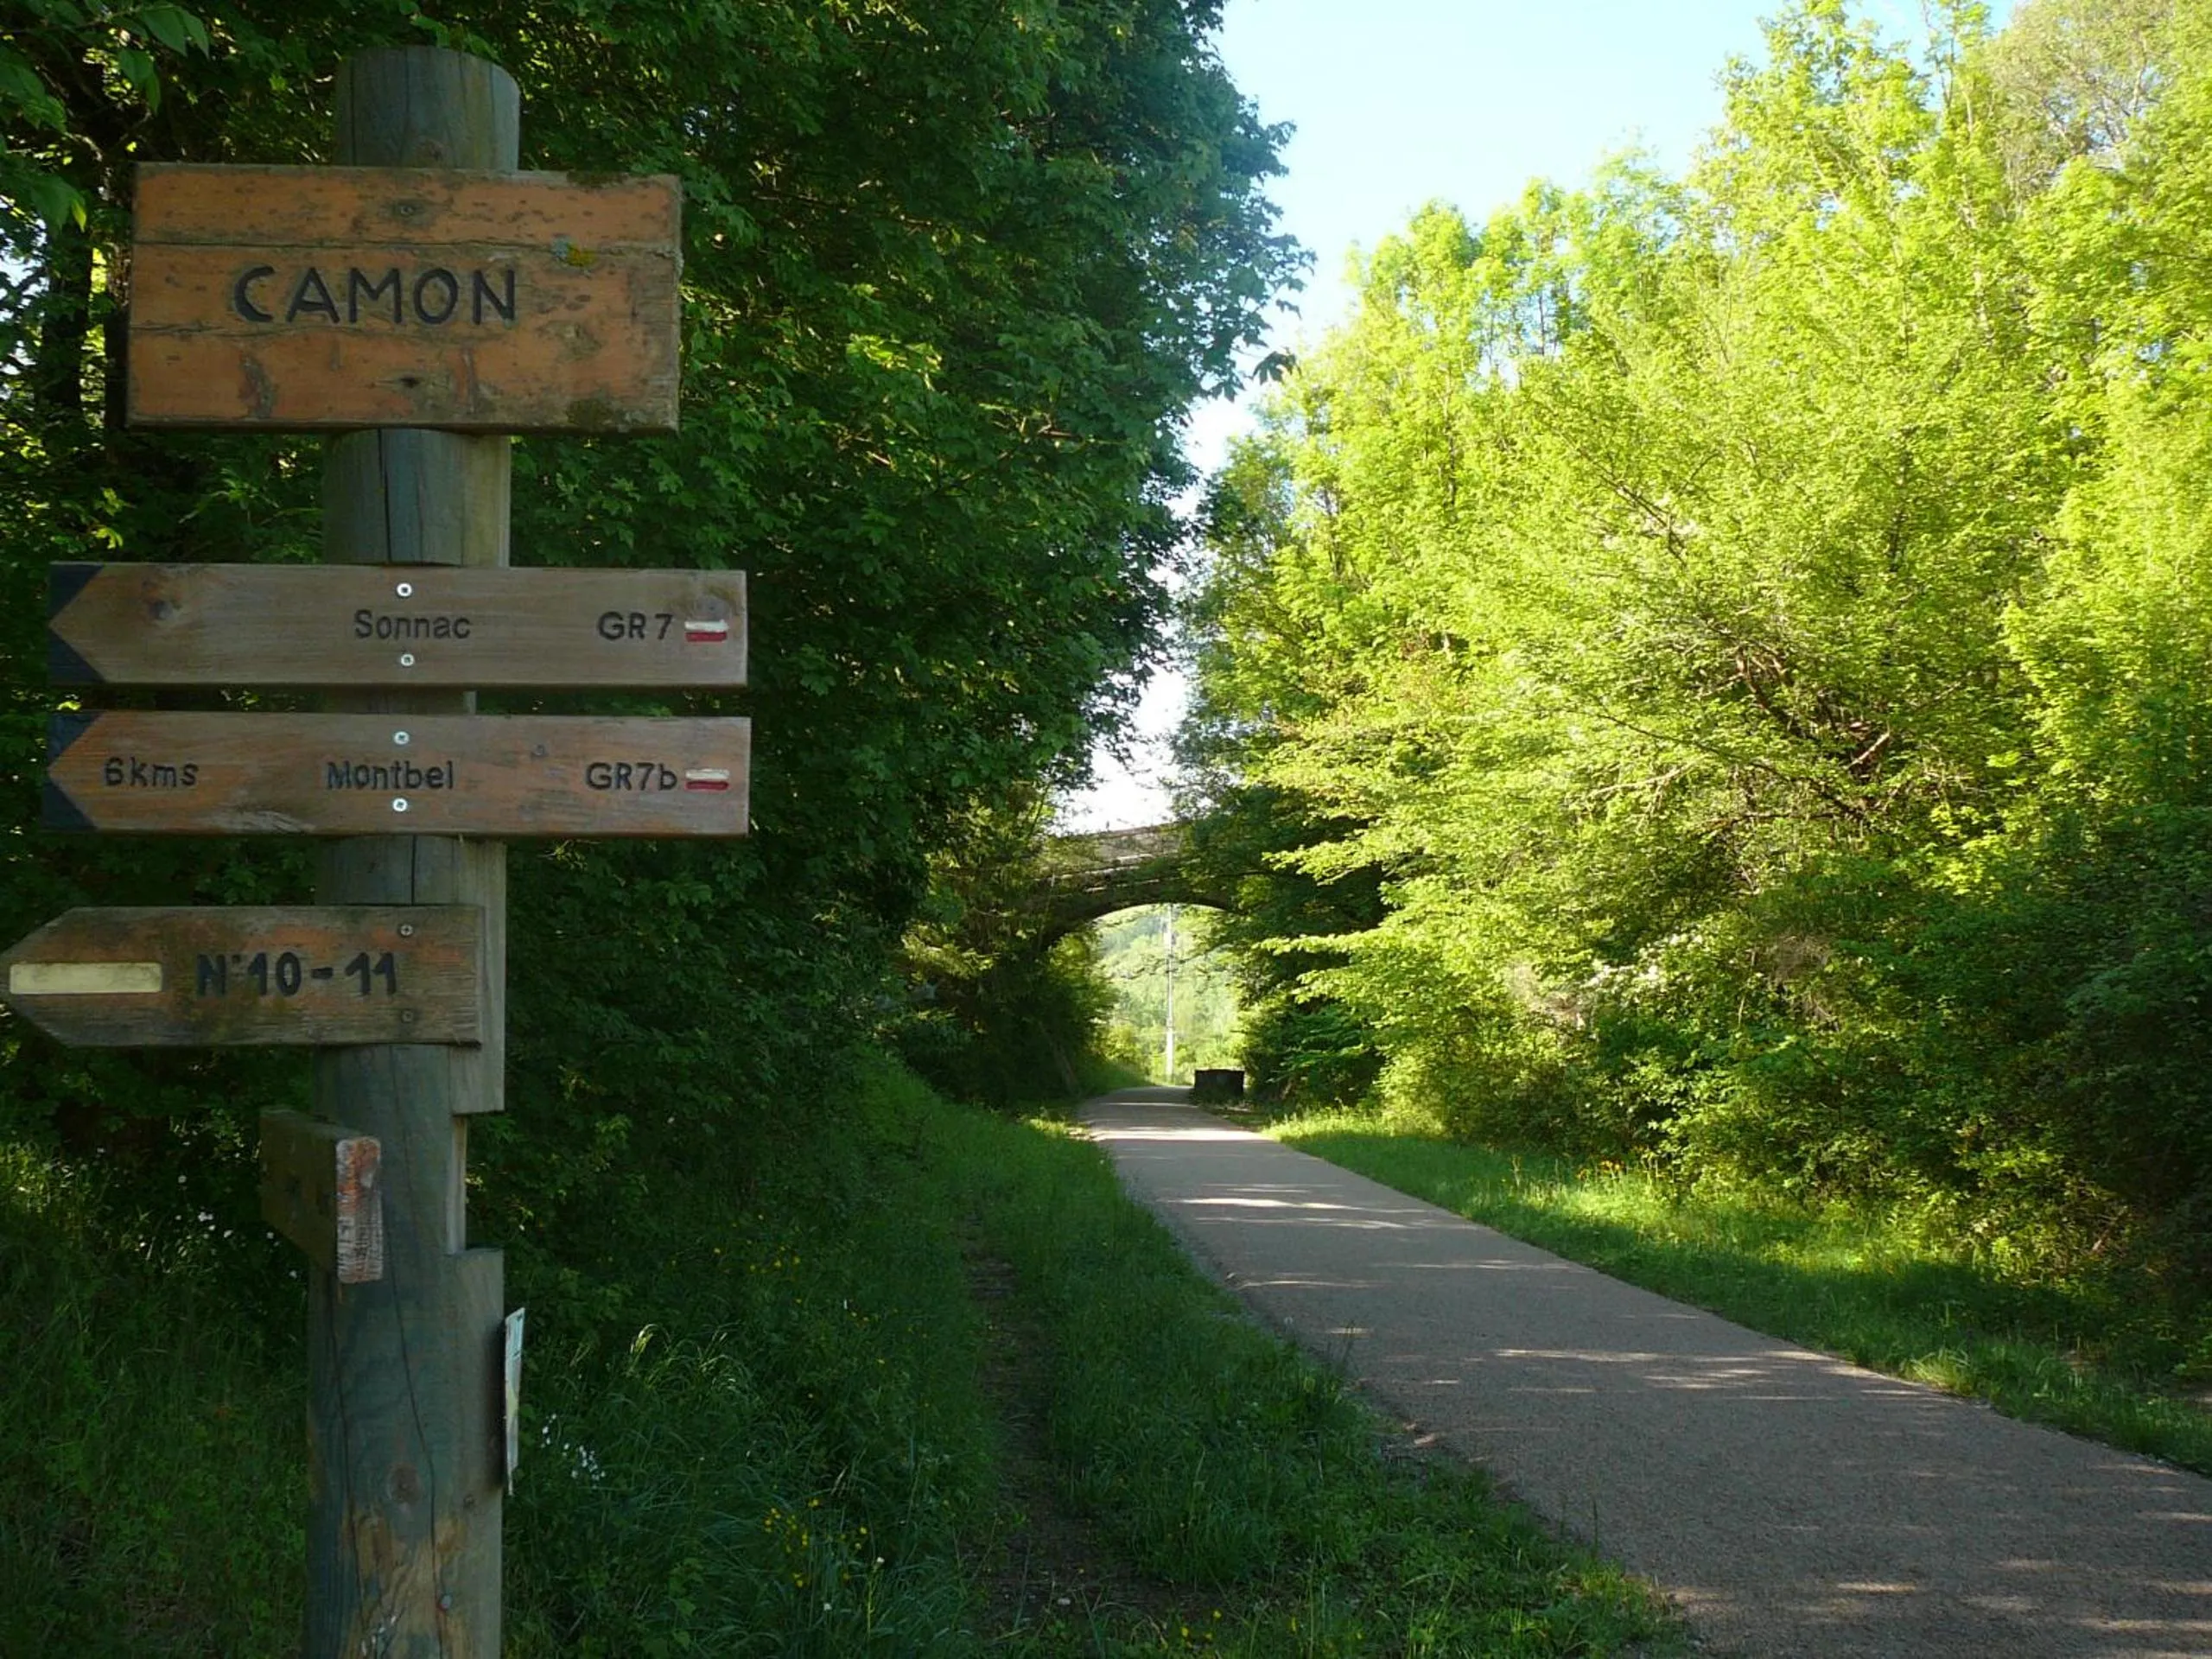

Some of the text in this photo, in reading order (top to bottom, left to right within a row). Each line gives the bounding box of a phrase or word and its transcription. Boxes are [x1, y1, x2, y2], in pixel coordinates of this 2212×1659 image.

[233, 265, 516, 326] CAMON
[353, 608, 472, 639] Sonnac
[327, 760, 454, 791] Montbel
[585, 761, 678, 791] GR7b
